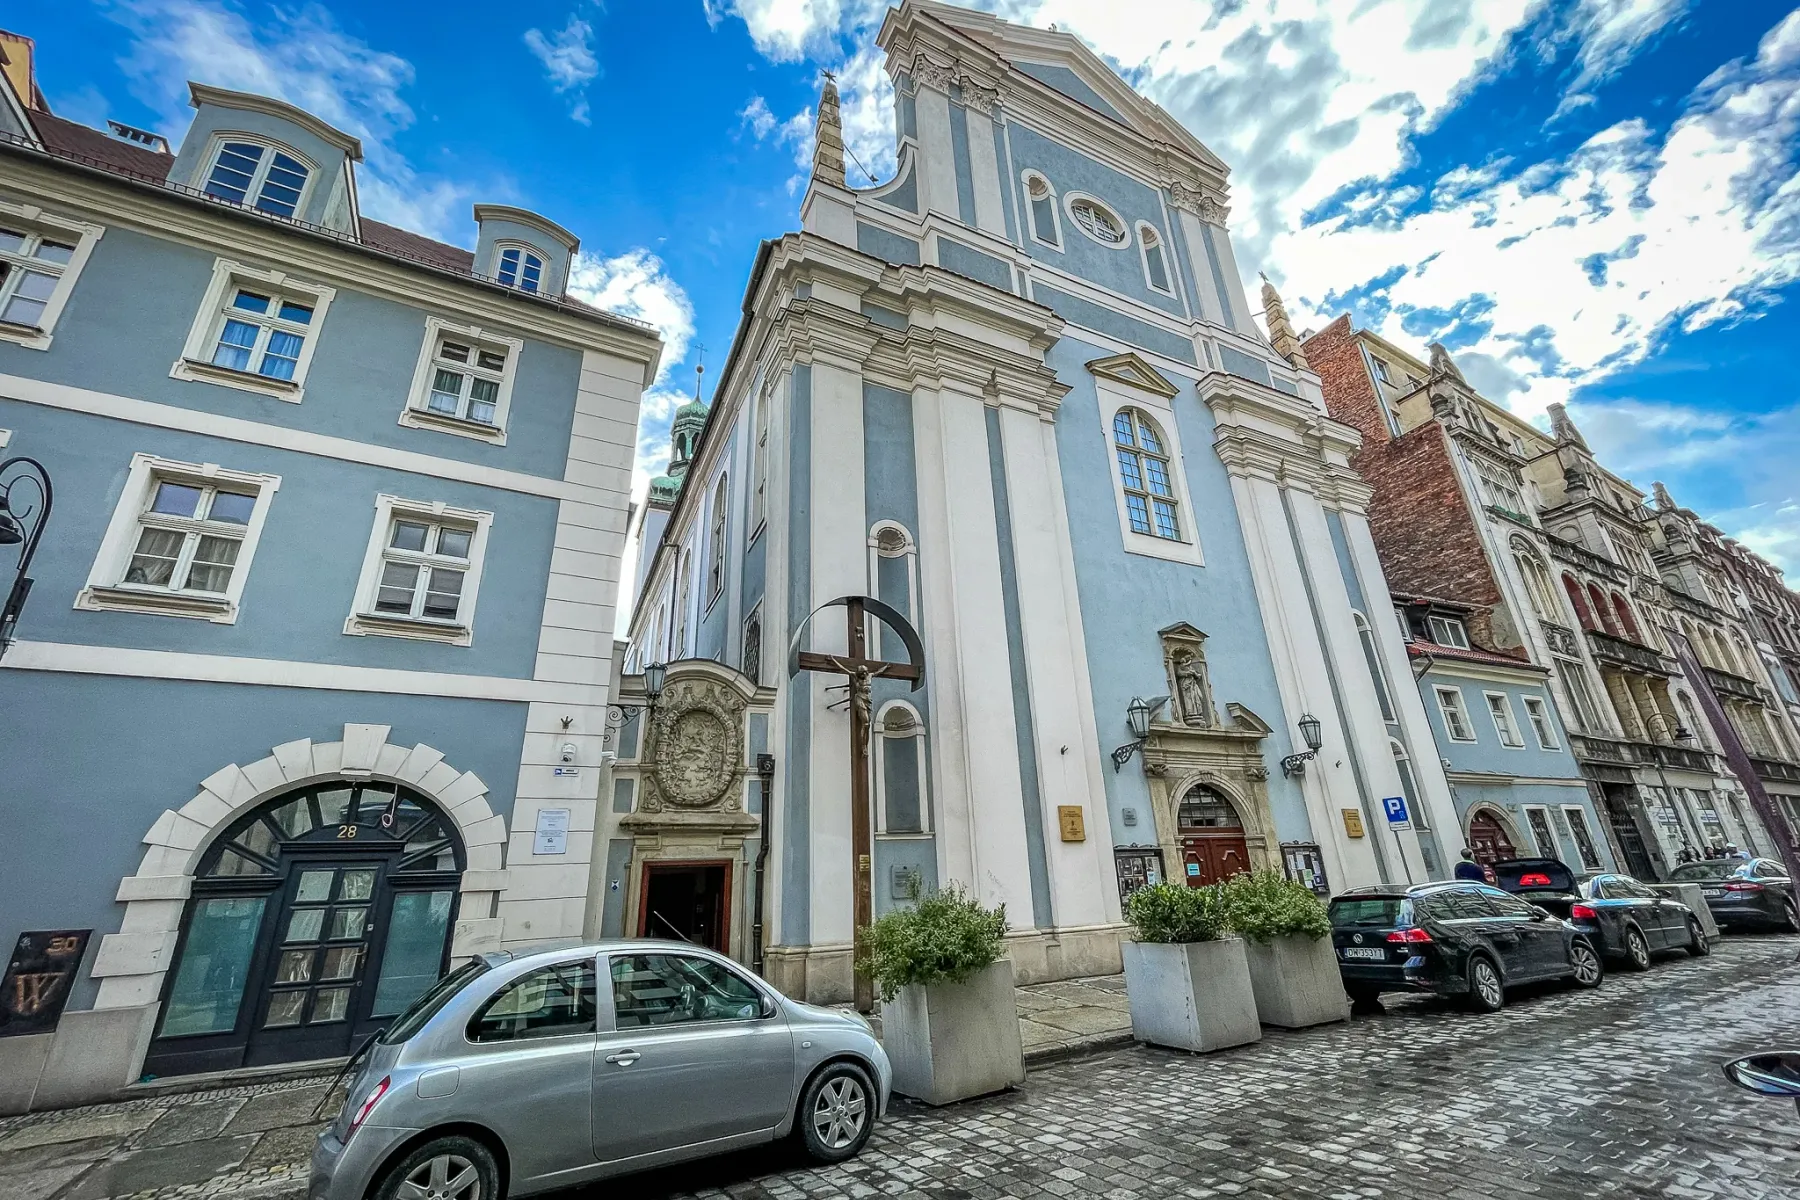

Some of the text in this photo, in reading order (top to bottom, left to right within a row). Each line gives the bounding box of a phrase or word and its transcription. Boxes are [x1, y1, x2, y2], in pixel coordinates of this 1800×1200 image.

[1387, 799, 1401, 815] P
[336, 825, 357, 838] 28
[46, 936, 79, 956] 30
